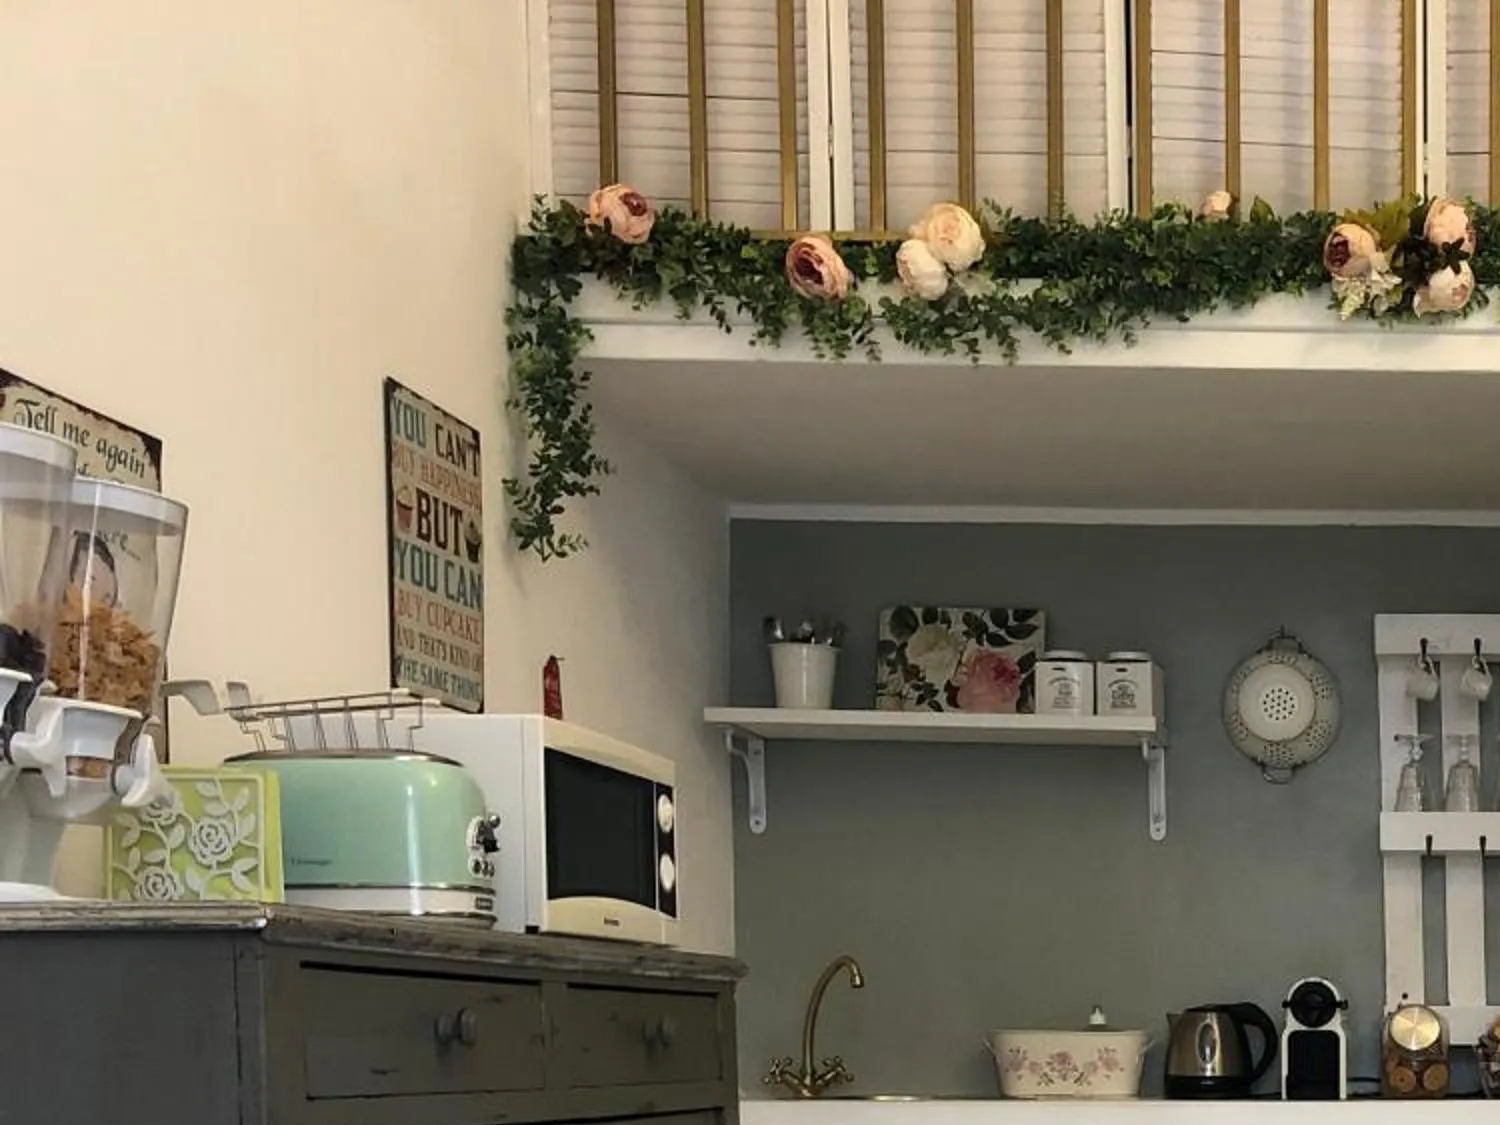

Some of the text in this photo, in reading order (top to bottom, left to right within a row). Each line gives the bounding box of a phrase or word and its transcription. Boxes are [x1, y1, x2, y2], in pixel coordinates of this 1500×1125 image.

[14, 398, 146, 478] Tell me again
[393, 399, 426, 448] YOU
[416, 487, 463, 557] BUT
[395, 538, 482, 613] YOU CAN
[397, 587, 422, 623] BUY
